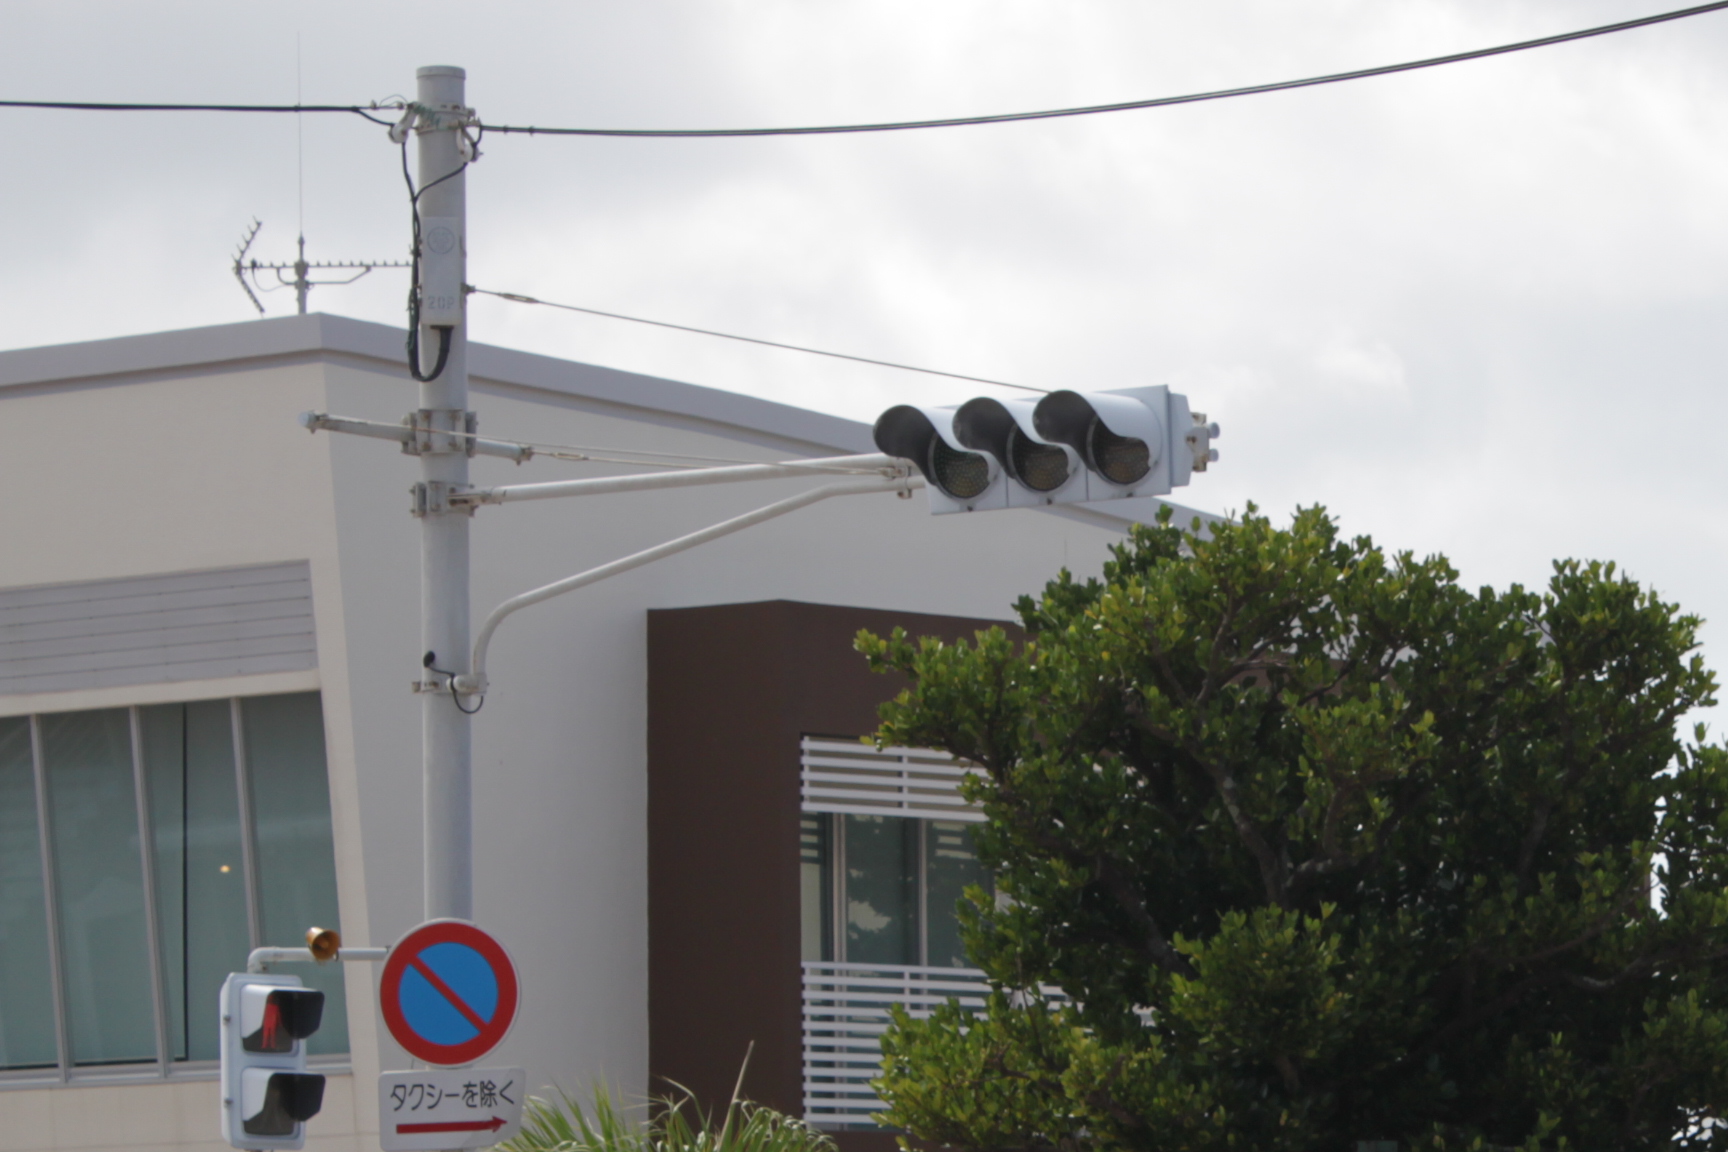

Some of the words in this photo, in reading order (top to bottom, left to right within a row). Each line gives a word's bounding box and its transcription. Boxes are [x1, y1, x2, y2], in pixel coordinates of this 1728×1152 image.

[390, 1079, 515, 1112] タクシーを除く
